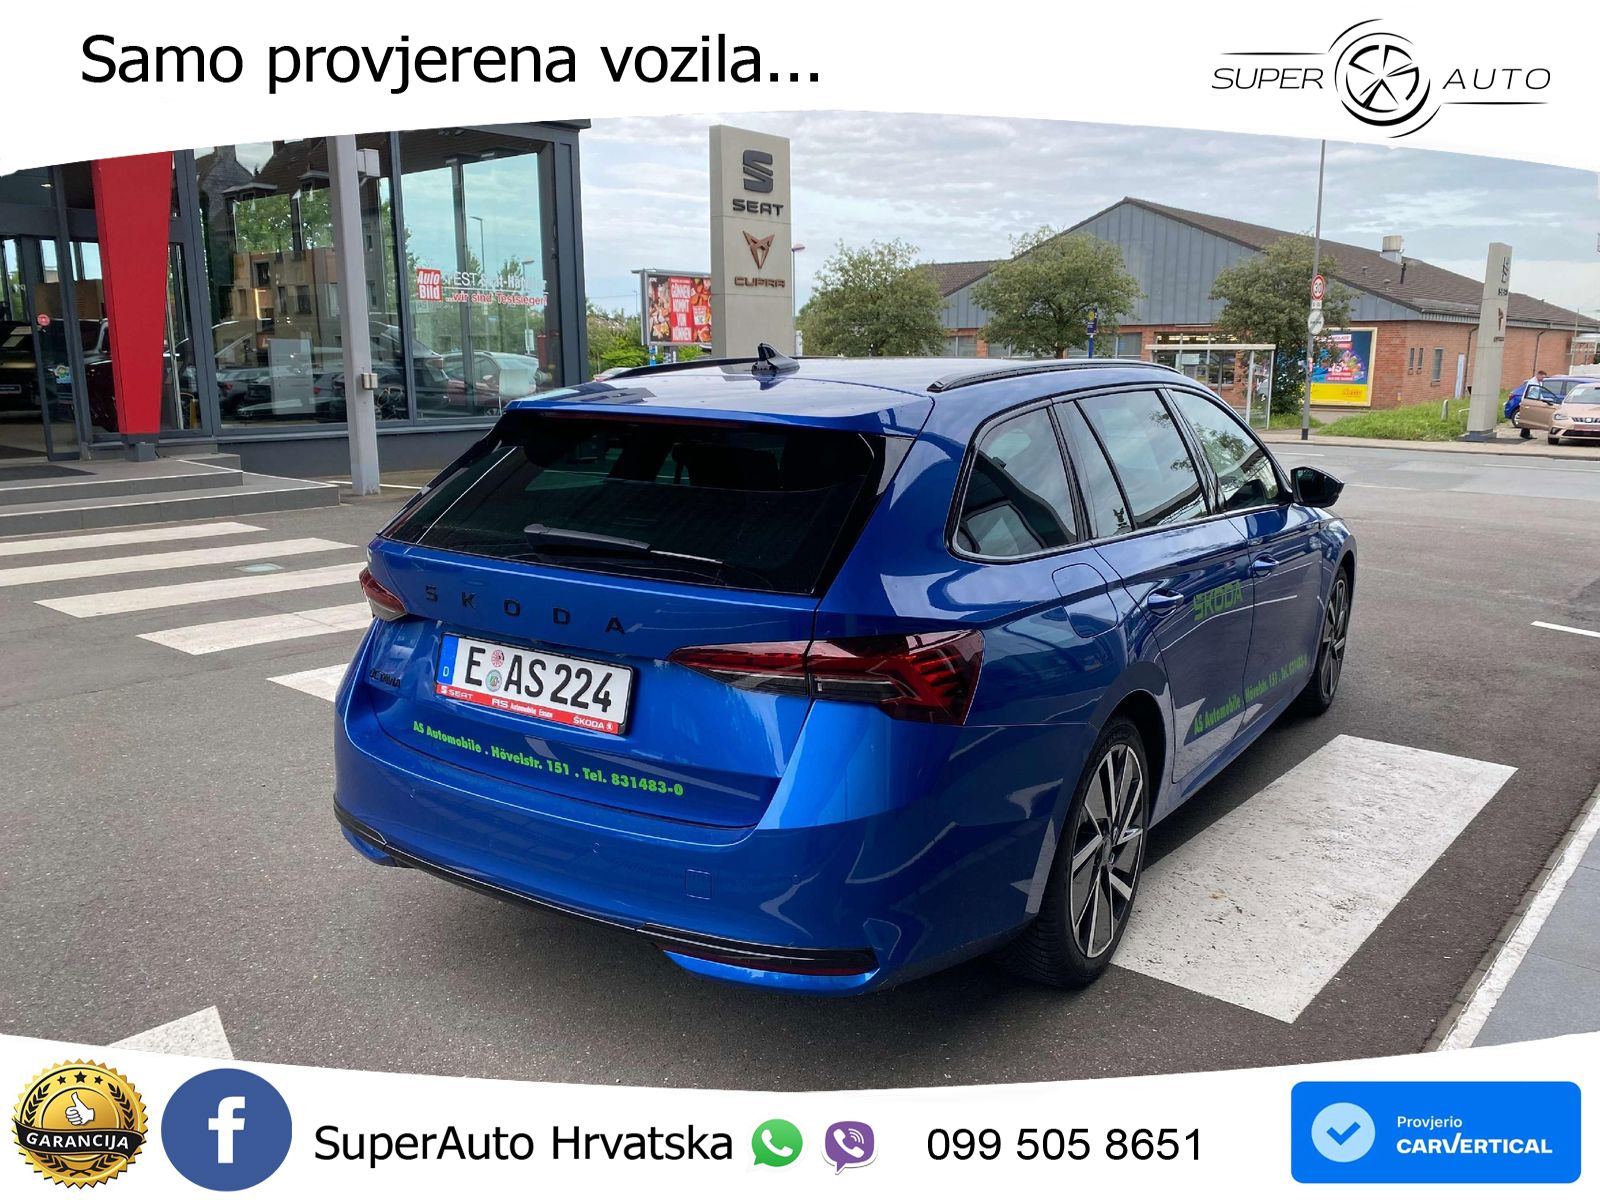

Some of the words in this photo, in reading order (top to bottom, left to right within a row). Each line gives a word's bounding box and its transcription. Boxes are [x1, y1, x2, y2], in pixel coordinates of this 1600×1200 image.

[732, 198, 784, 217] SEAT
[417, 271, 440, 285] Auto
[734, 276, 786, 289] CUPRA
[419, 284, 440, 300] Bild
[1314, 281, 1322, 294] 30
[471, 291, 493, 304] sind
[425, 585, 626, 635] SKODA
[465, 646, 486, 686] E
[448, 689, 473, 700] SEAT
[491, 698, 509, 709] AS
[413, 720, 424, 734] AS
[426, 727, 482, 753] Automobile
[491, 745, 543, 770] Hövelstr.
[547, 759, 570, 776] 151
[582, 767, 608, 783] Tel.
[611, 773, 685, 797] 831483-0
